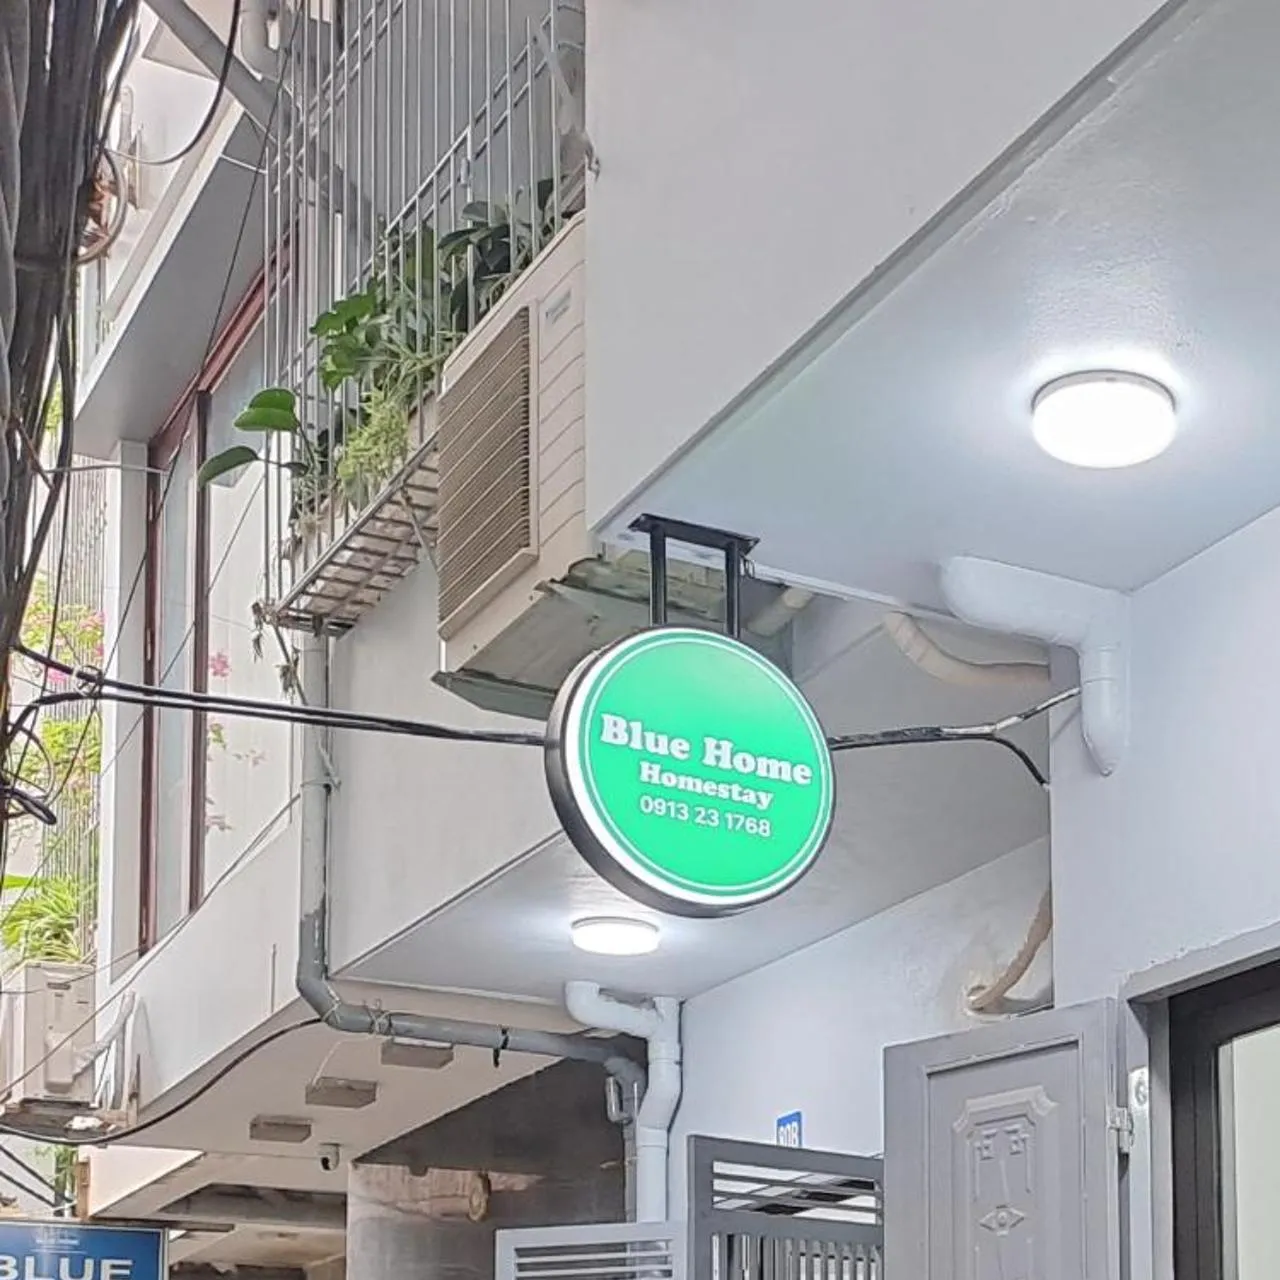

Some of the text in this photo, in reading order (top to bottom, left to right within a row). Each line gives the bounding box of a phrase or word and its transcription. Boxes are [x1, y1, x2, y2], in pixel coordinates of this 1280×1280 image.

[600, 713, 813, 785] Blue Home
[640, 761, 773, 810] Homestay
[640, 795, 771, 838] 0913 23 1768
